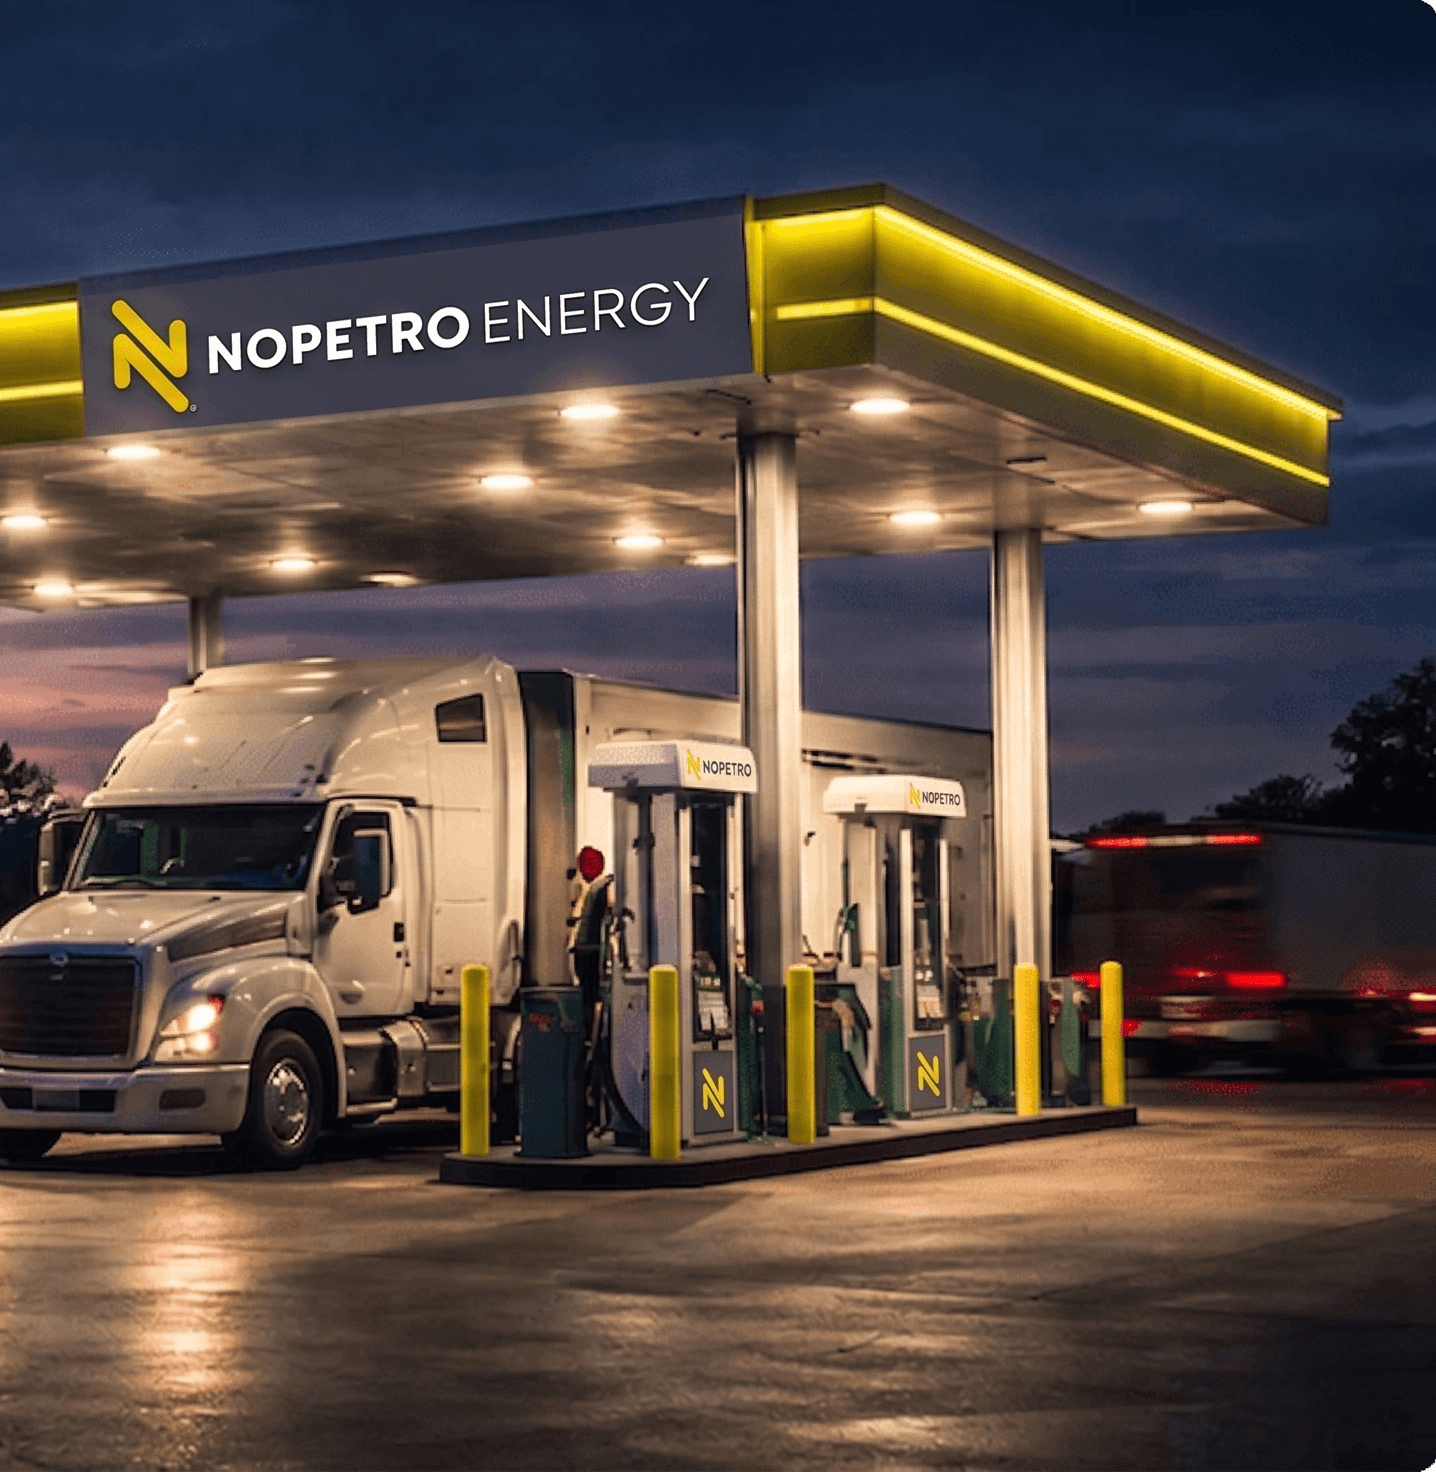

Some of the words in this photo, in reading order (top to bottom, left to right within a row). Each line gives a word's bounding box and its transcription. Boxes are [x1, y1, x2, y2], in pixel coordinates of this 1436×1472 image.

[208, 305, 470, 374] NOPETRO
[485, 277, 710, 344] ENERGY
[702, 759, 752, 777] NOPETRO
[922, 791, 961, 806] NOPETRO
